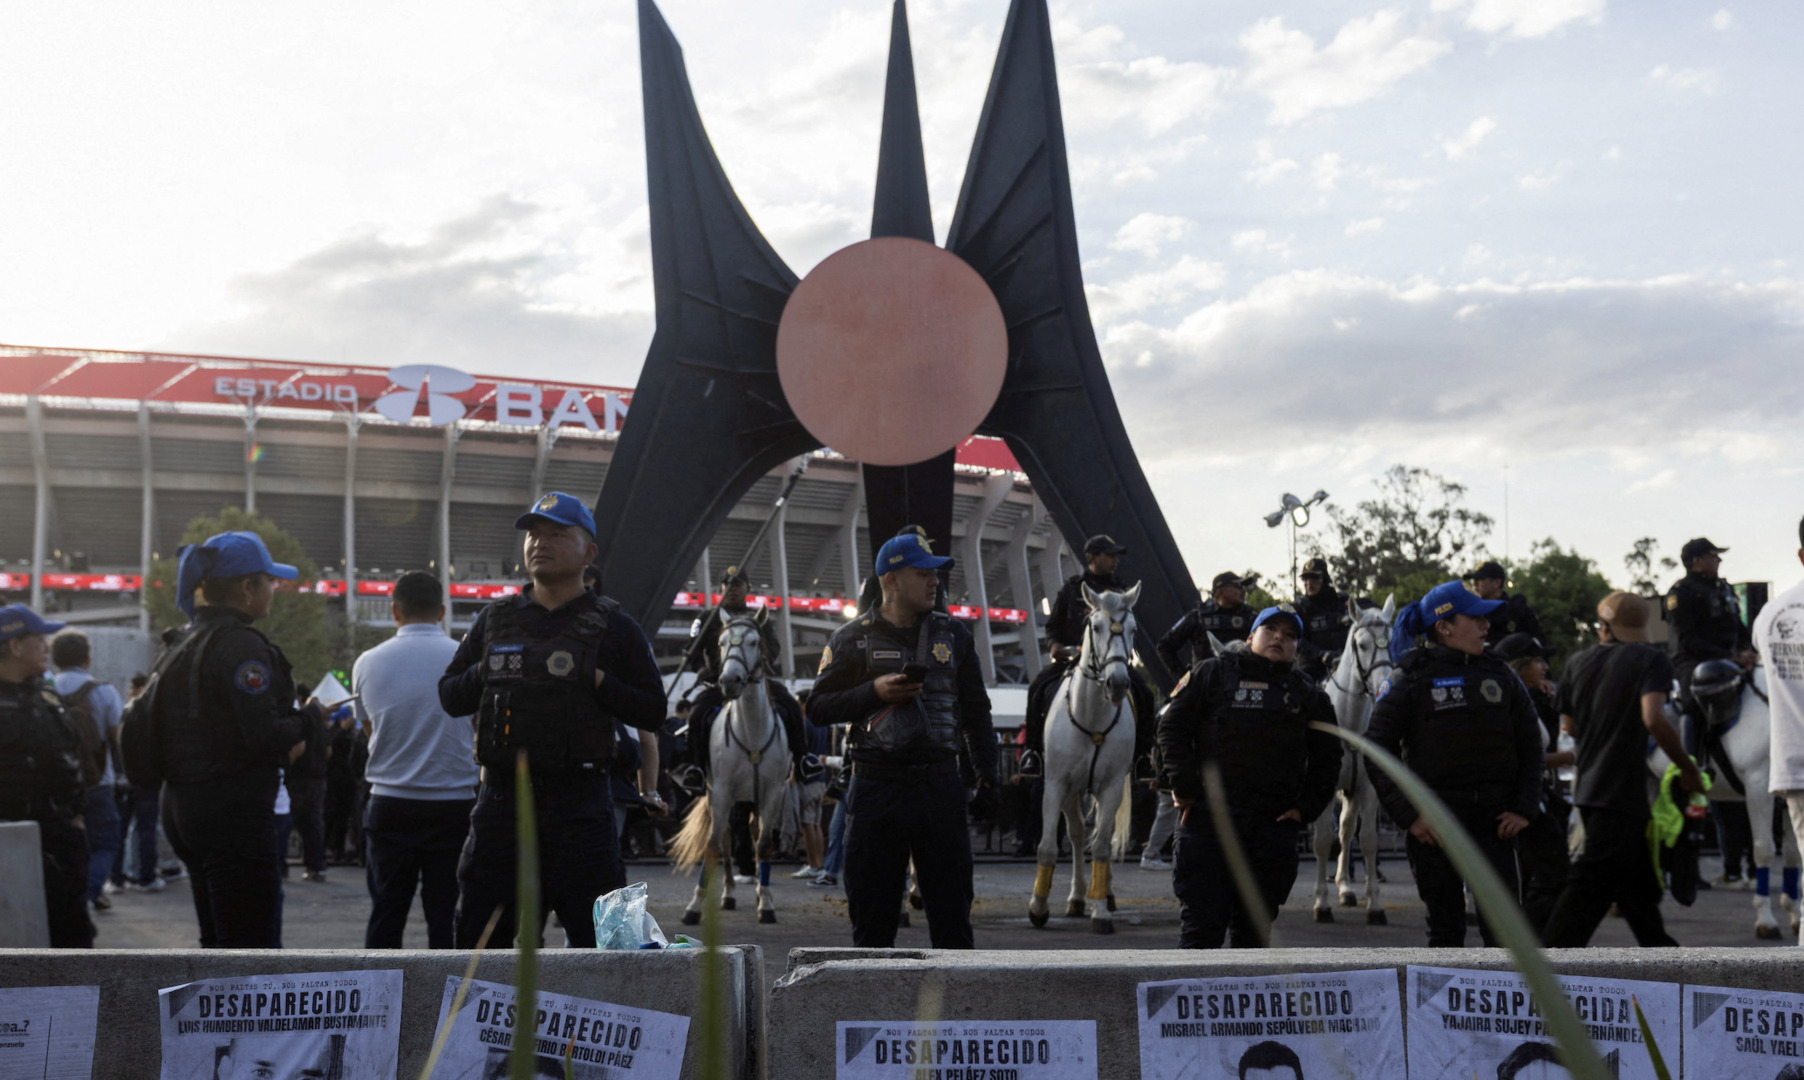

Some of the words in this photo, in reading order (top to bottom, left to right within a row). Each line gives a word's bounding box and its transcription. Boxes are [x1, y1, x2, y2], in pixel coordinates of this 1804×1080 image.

[215, 377, 358, 403] ESTADIO
[334, 979, 357, 987] TODOS
[1482, 979, 1513, 987] FALTAS
[1599, 986, 1626, 995] TODOS
[199, 989, 361, 1018] DESAPARECIDO
[492, 991, 506, 999] NOS
[564, 1003, 578, 1012] NOS
[584, 1007, 613, 1018] FALTAN
[617, 1013, 641, 1023] TODOS
[1178, 990, 1354, 1019] DESAPARECIDO
[1448, 987, 1630, 1024] DESAPACIDA
[1760, 999, 1793, 1008] FALTAS
[178, 1020, 200, 1034] LUIS
[203, 1019, 254, 1033] HUMBERTO
[258, 1017, 321, 1032] VALDELAMAR
[323, 1015, 386, 1030] BUSTAMANTE
[476, 999, 642, 1050] DESPARECIDO
[1161, 1023, 1207, 1038] MISRAEL
[1211, 1022, 1263, 1036] ARMANDO
[1267, 1018, 1325, 1035] SEPÚLVEDA
[1442, 1014, 1491, 1032] YAJAIRA
[1495, 1018, 1531, 1035] SUJEY
[1584, 1023, 1645, 1043] ERNÁNDEZ
[1726, 1007, 1804, 1037] DESAP
[480, 1028, 512, 1046] CÉSAR
[607, 1051, 633, 1069] PÁEZ
[876, 1039, 1050, 1064] DESAPARECIDO
[1736, 1035, 1766, 1054] SAÚL
[1770, 1040, 1799, 1057] YAEL
[916, 1069, 942, 1080] ALEX
[990, 1068, 1017, 1080] SOTO
